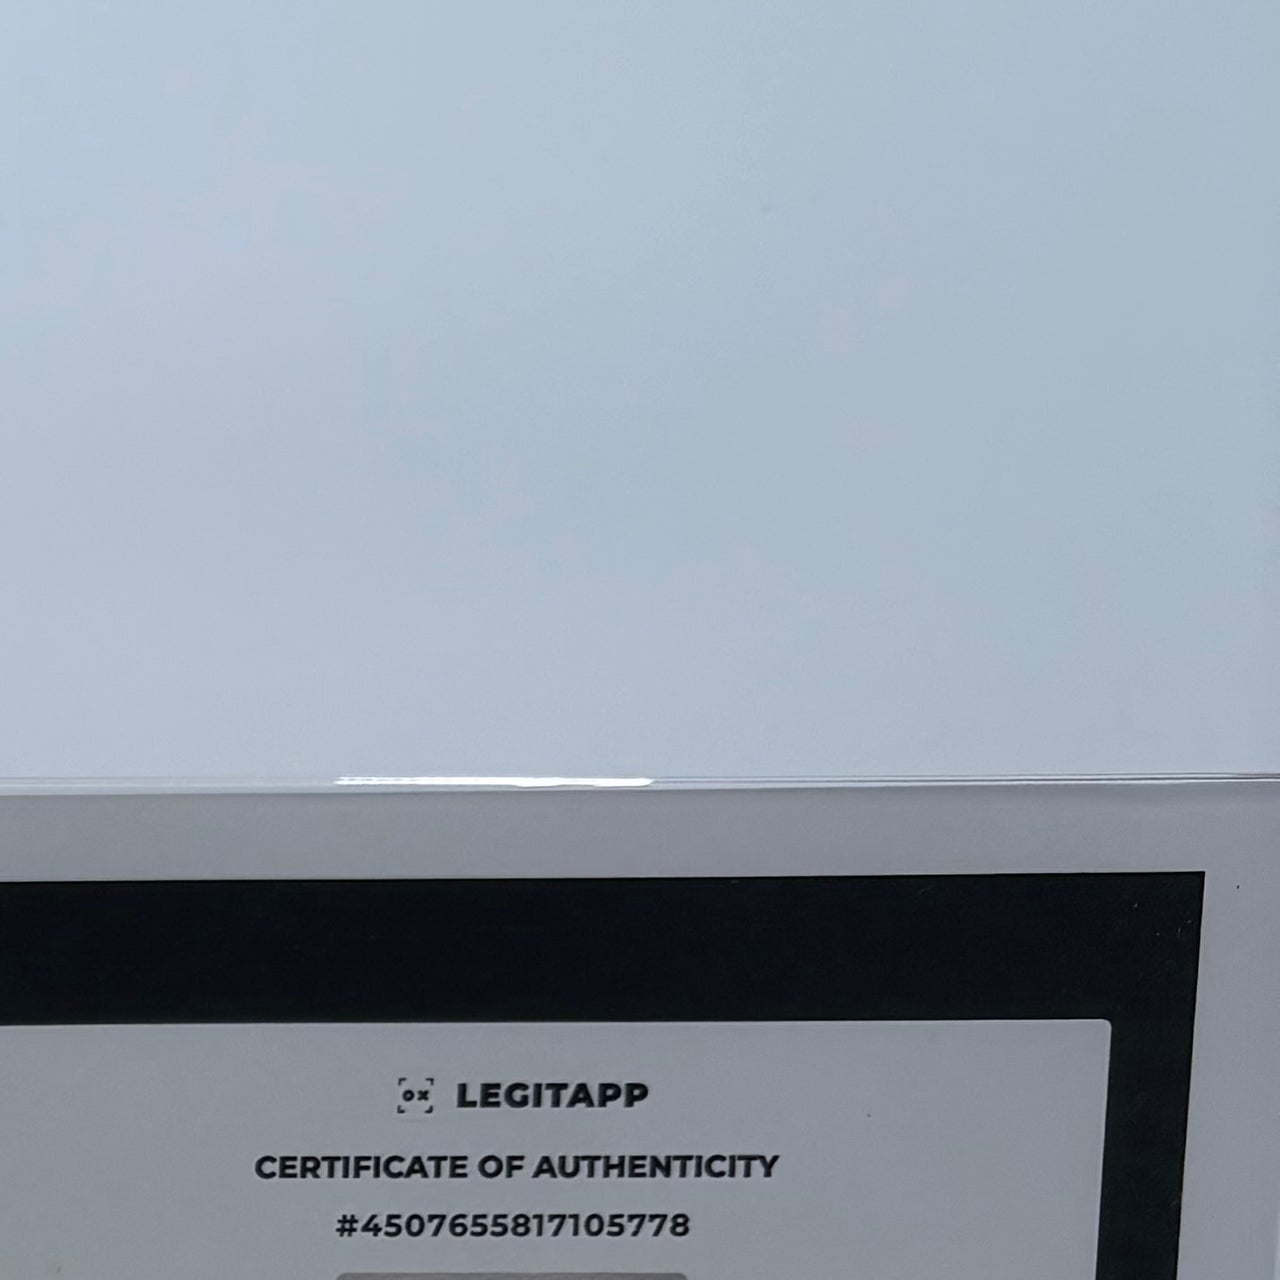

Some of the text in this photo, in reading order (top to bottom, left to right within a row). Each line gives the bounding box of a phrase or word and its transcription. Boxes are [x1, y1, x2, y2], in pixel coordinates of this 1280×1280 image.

[456, 1081, 650, 1110] LEGITAPP
[254, 1153, 781, 1181] CERTIFICATE OF AUTHENTICITY
[335, 1212, 691, 1239] #4507655817105778
